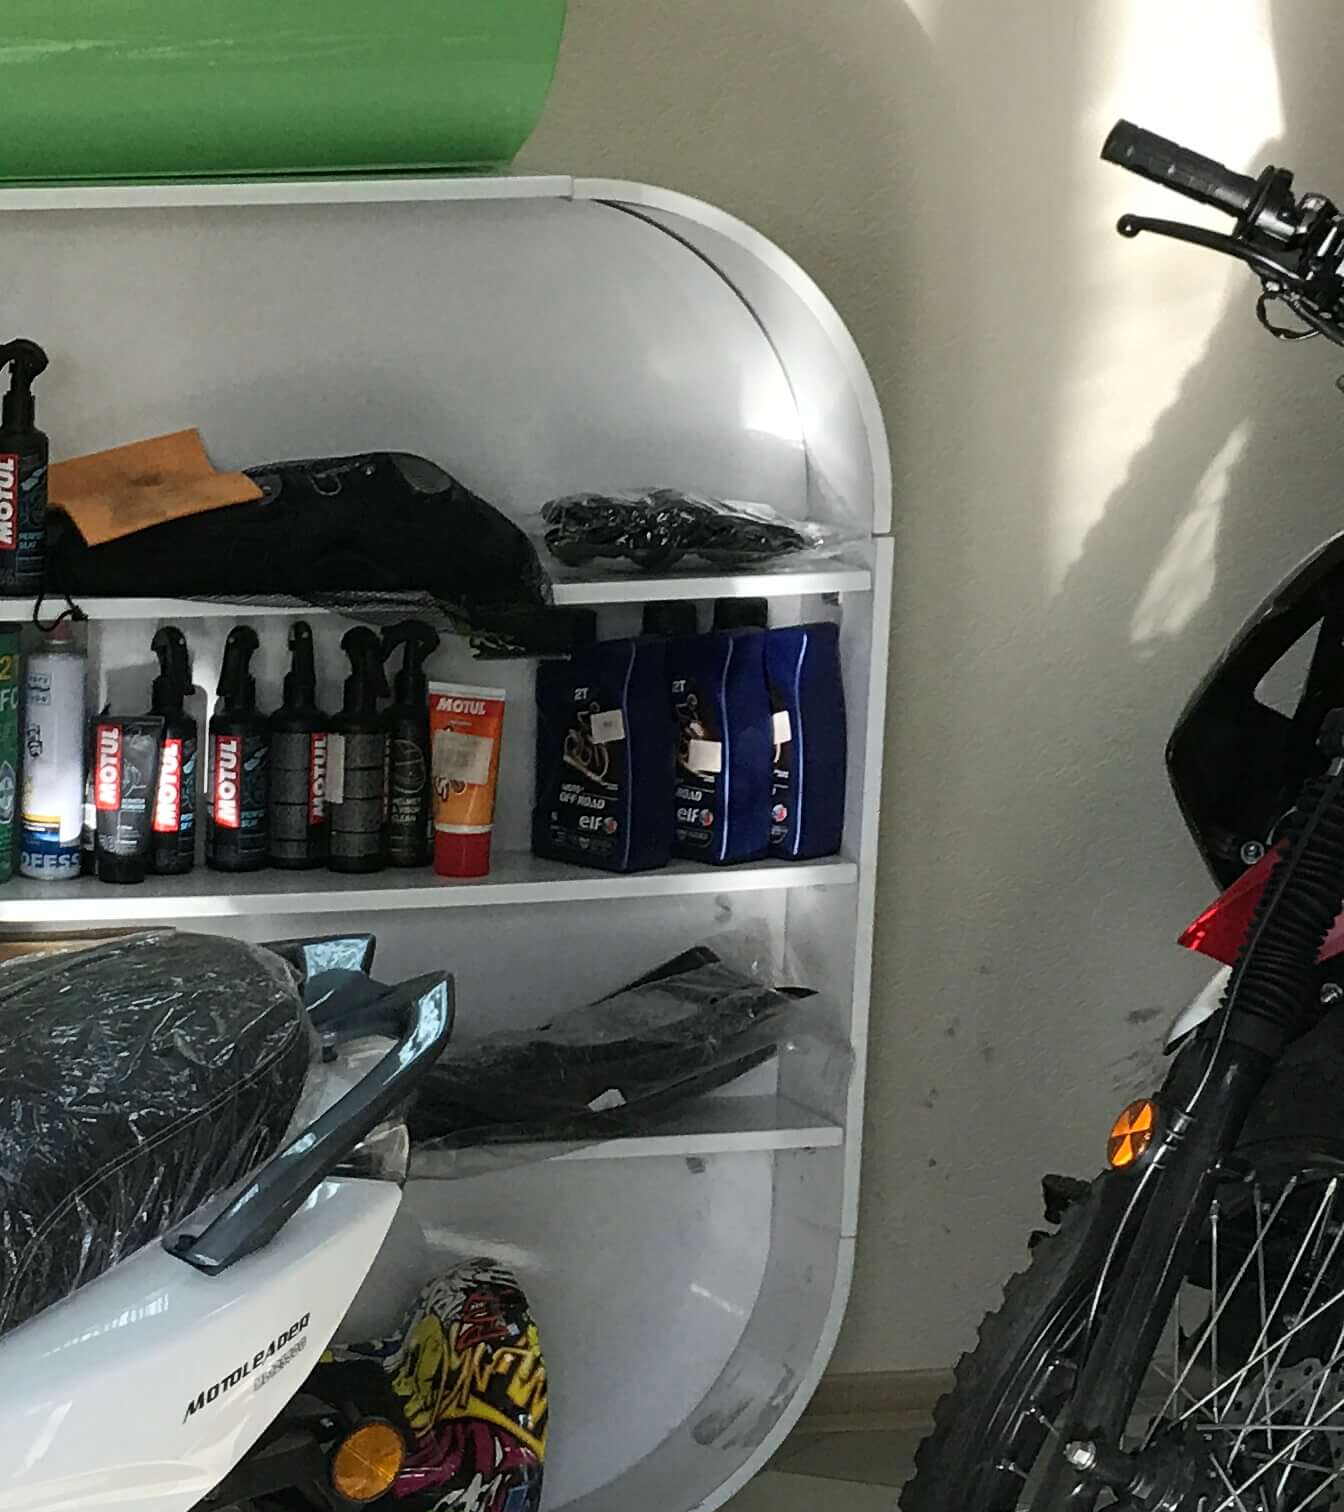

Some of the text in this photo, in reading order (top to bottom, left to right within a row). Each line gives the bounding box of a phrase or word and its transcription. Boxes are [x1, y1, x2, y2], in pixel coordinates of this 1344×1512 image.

[436, 698, 487, 716] MOTUL
[573, 687, 589, 700] 2T
[98, 727, 119, 804] MOTUL
[154, 743, 179, 826] MOTUL
[218, 740, 238, 824] MOTUL
[311, 736, 327, 818] MOTUL
[559, 793, 577, 805] OFF
[676, 807, 701, 824] elf
[579, 815, 605, 831] elf
[182, 1312, 311, 1425] MOTOLEADER
